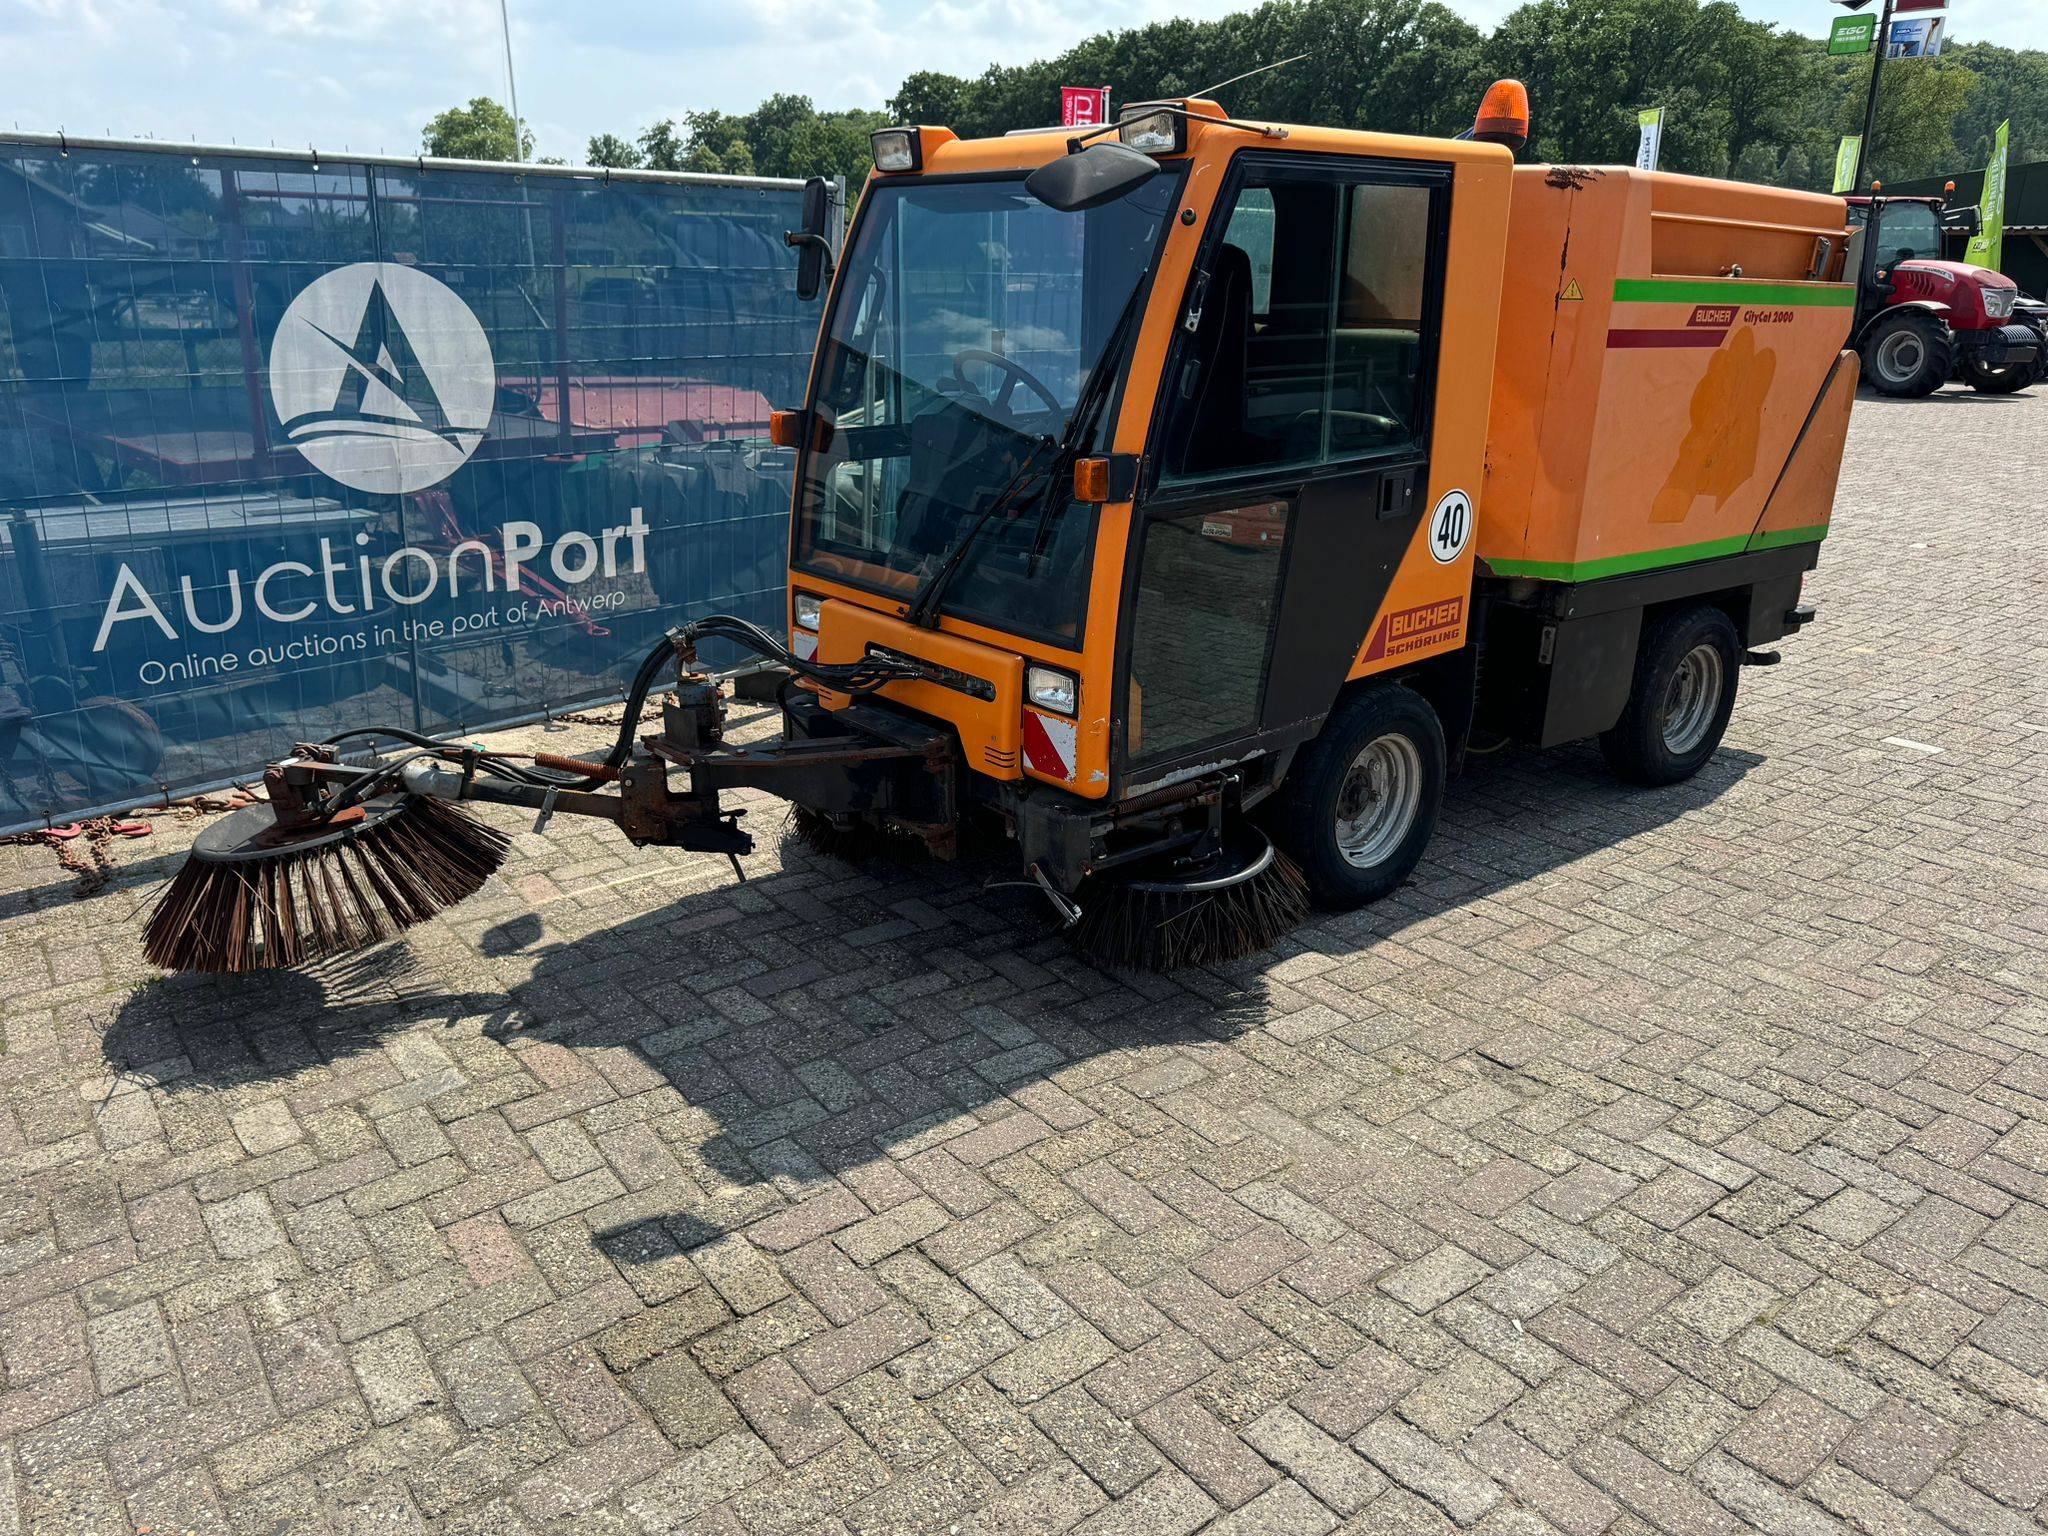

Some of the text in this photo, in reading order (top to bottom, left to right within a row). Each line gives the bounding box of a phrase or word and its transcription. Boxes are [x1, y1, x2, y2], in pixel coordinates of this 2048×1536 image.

[1837, 26, 1867, 35] EGO
[1695, 309, 1732, 323] BUCHER
[1743, 310, 1794, 326] CityCat 2000
[1437, 503, 1464, 549] 40
[93, 507, 650, 652] AuctionPort
[1391, 602, 1459, 634] BUCHER
[139, 590, 626, 685] Online auctions in the port of Antwerp
[1386, 629, 1459, 657] SCHÖRLING
